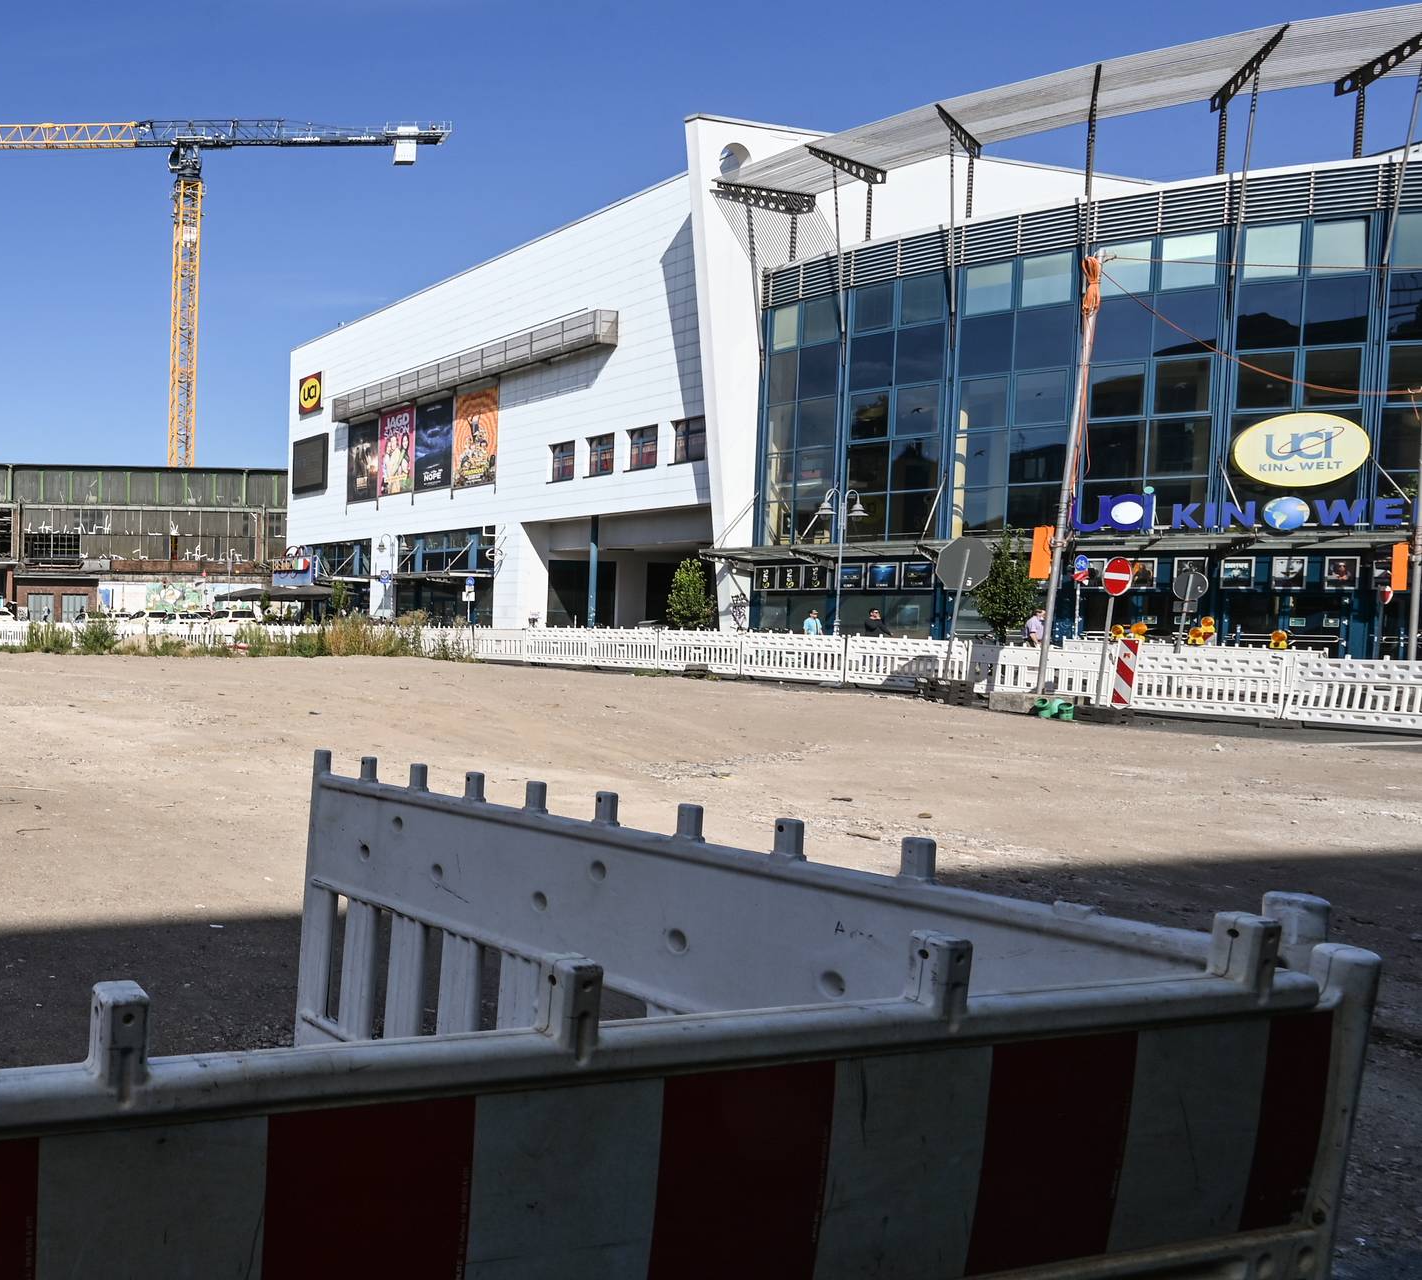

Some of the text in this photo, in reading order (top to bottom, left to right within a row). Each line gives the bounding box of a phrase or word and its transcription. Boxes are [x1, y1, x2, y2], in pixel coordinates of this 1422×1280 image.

[303, 384, 317, 401] UCI
[385, 413, 409, 430] JAGD
[1265, 432, 1333, 461] UCI
